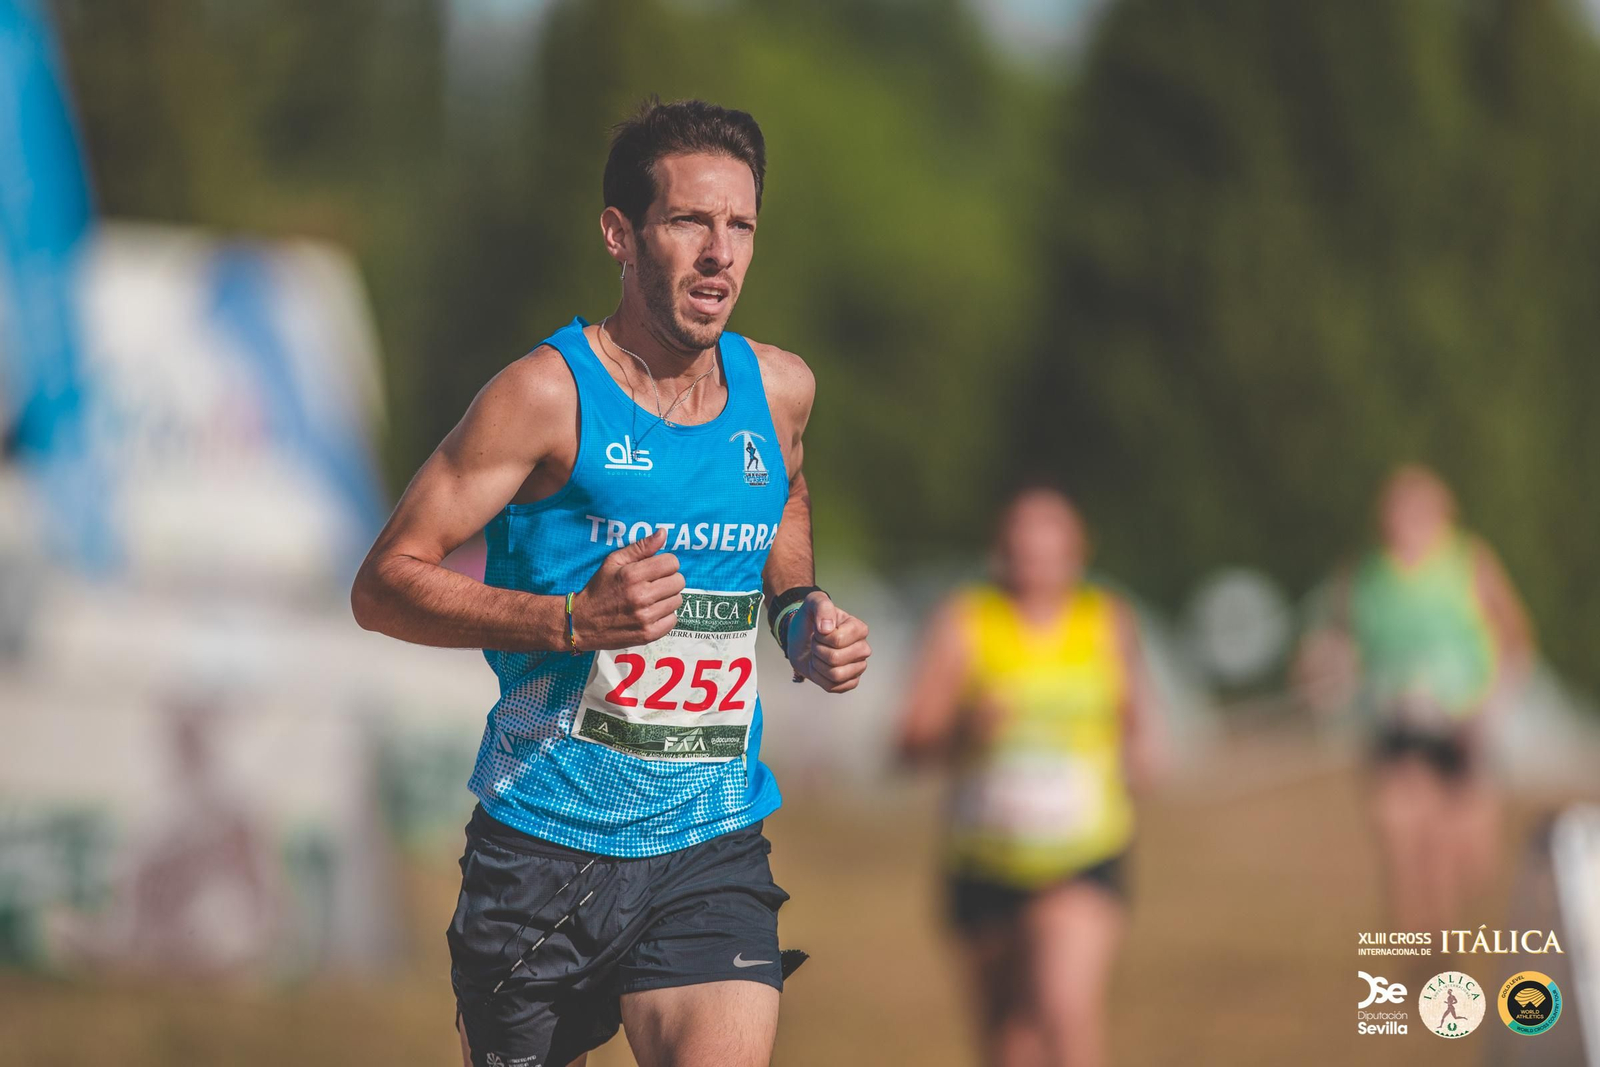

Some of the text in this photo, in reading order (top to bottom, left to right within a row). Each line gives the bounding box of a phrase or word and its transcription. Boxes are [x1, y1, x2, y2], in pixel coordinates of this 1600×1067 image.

[585, 514, 778, 552] TROTASIERRA
[674, 595, 740, 621] ÁLICA
[667, 630, 748, 640] SIERRA HORNACHUELOS
[604, 653, 753, 713] 2252
